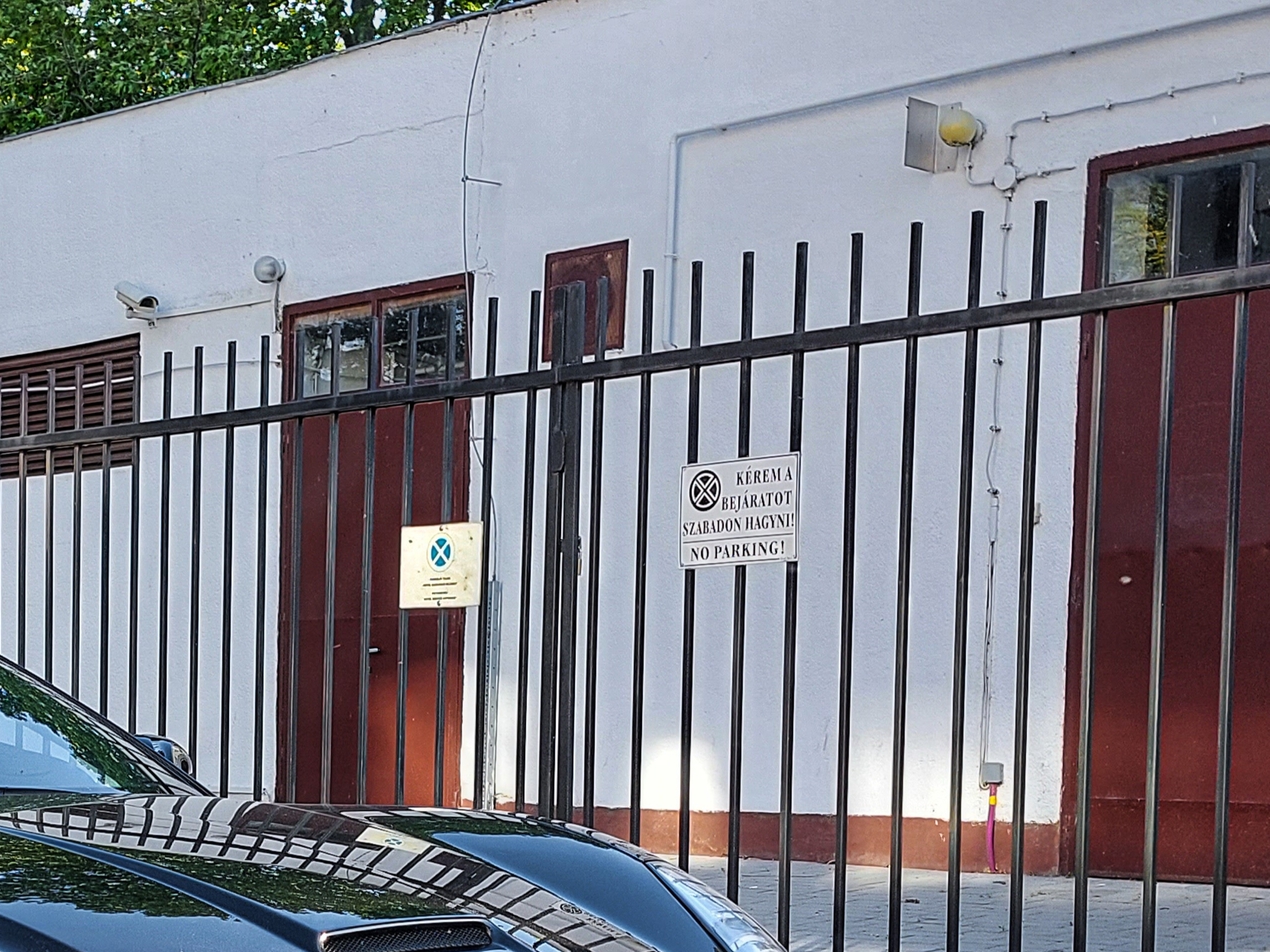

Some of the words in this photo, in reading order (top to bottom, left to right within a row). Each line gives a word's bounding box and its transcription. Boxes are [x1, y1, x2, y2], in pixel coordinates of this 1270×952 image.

[736, 465, 781, 486] KÉREM
[784, 466, 793, 481] A
[721, 490, 793, 513] BEJÁRATOT
[682, 517, 742, 536] SZABADON
[745, 513, 795, 531] HAGYNI!
[690, 546, 710, 562] NO
[714, 540, 785, 559] PARKING!
